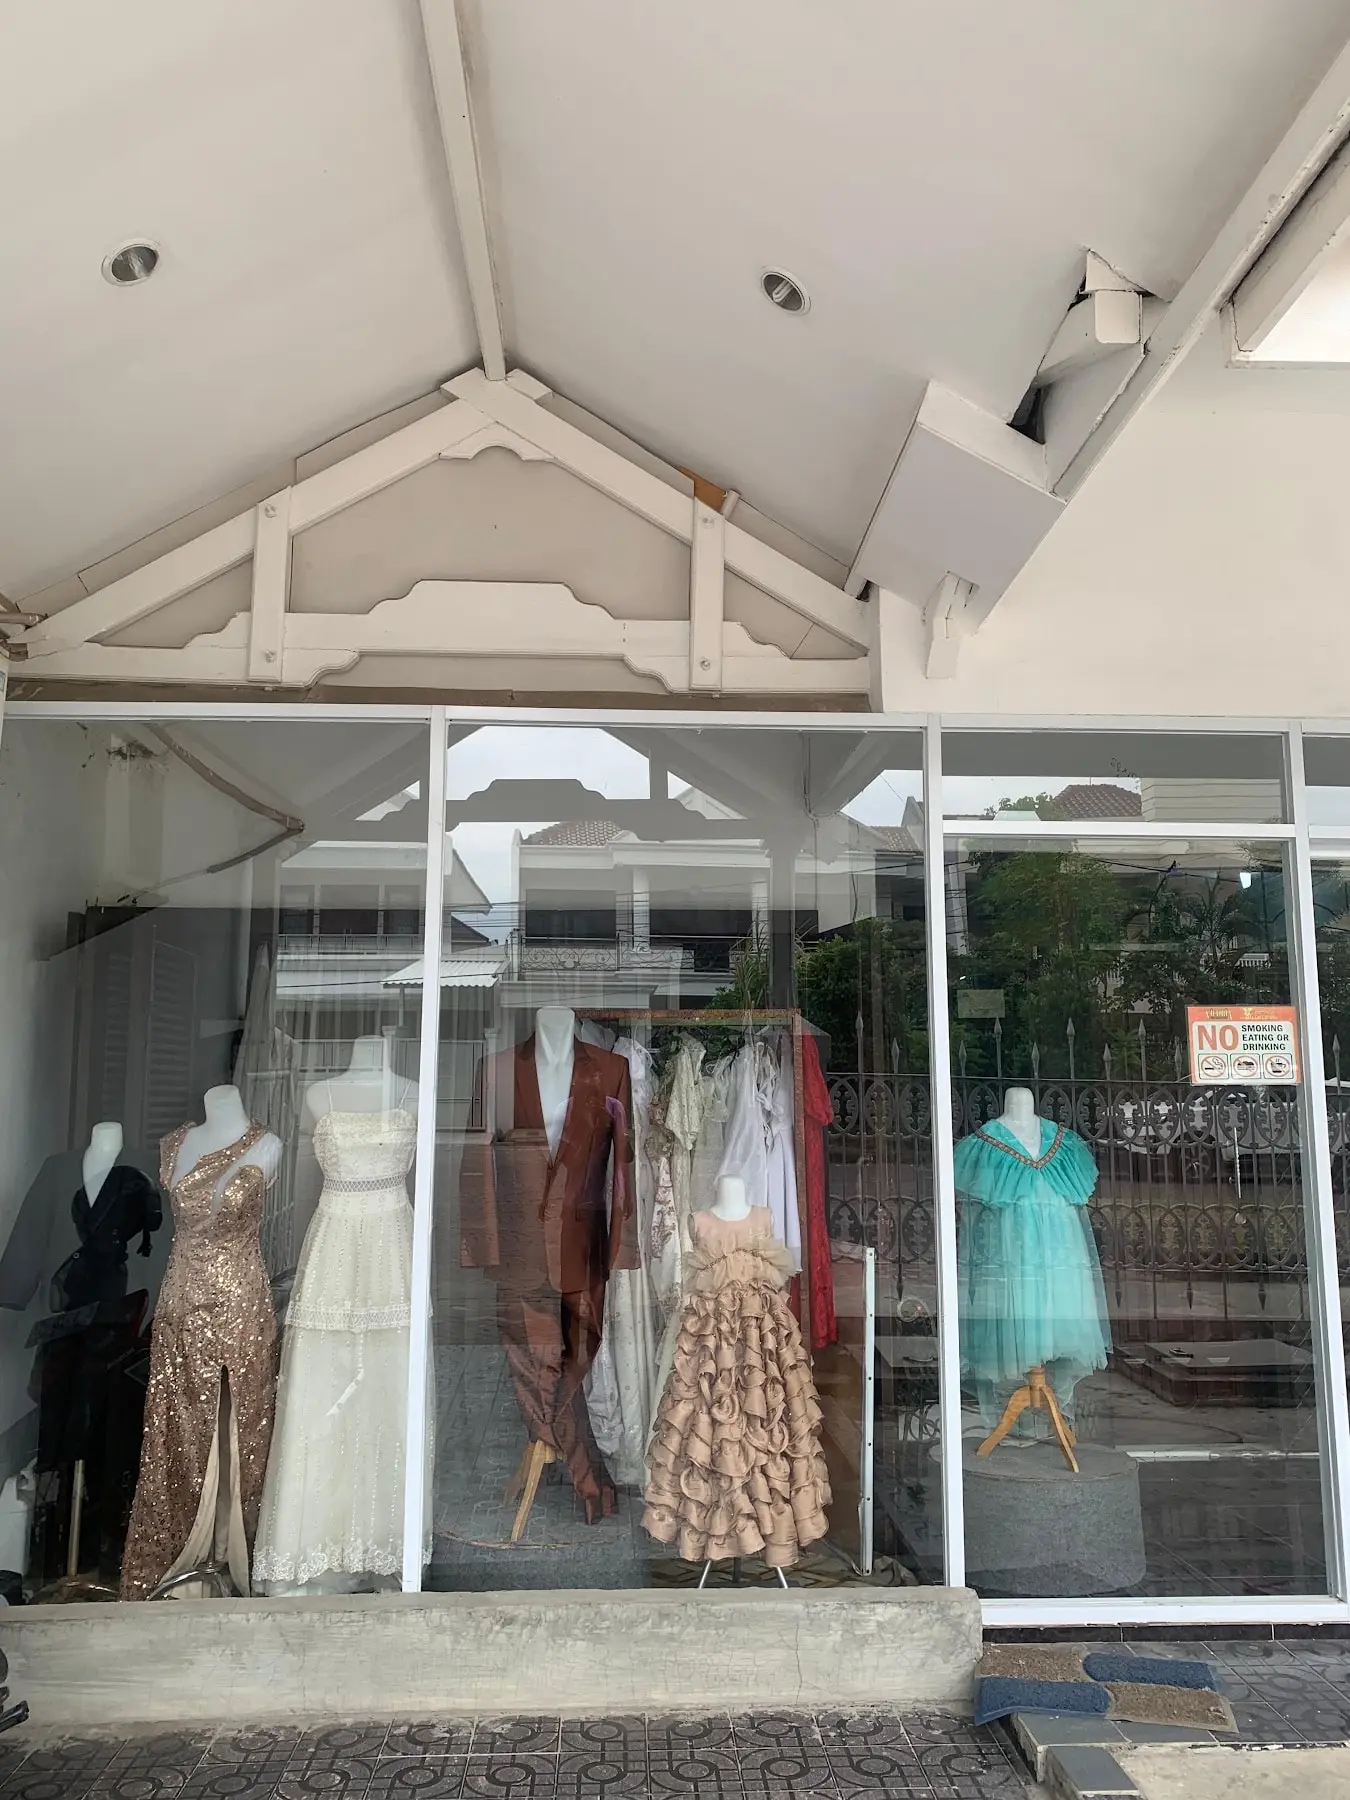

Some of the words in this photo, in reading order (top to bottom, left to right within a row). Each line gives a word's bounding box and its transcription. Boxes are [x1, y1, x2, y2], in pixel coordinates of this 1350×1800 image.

[1197, 1025, 1239, 1051] NO
[1242, 1034, 1274, 1042] EATING
[1243, 1043, 1286, 1051] DRINKING
